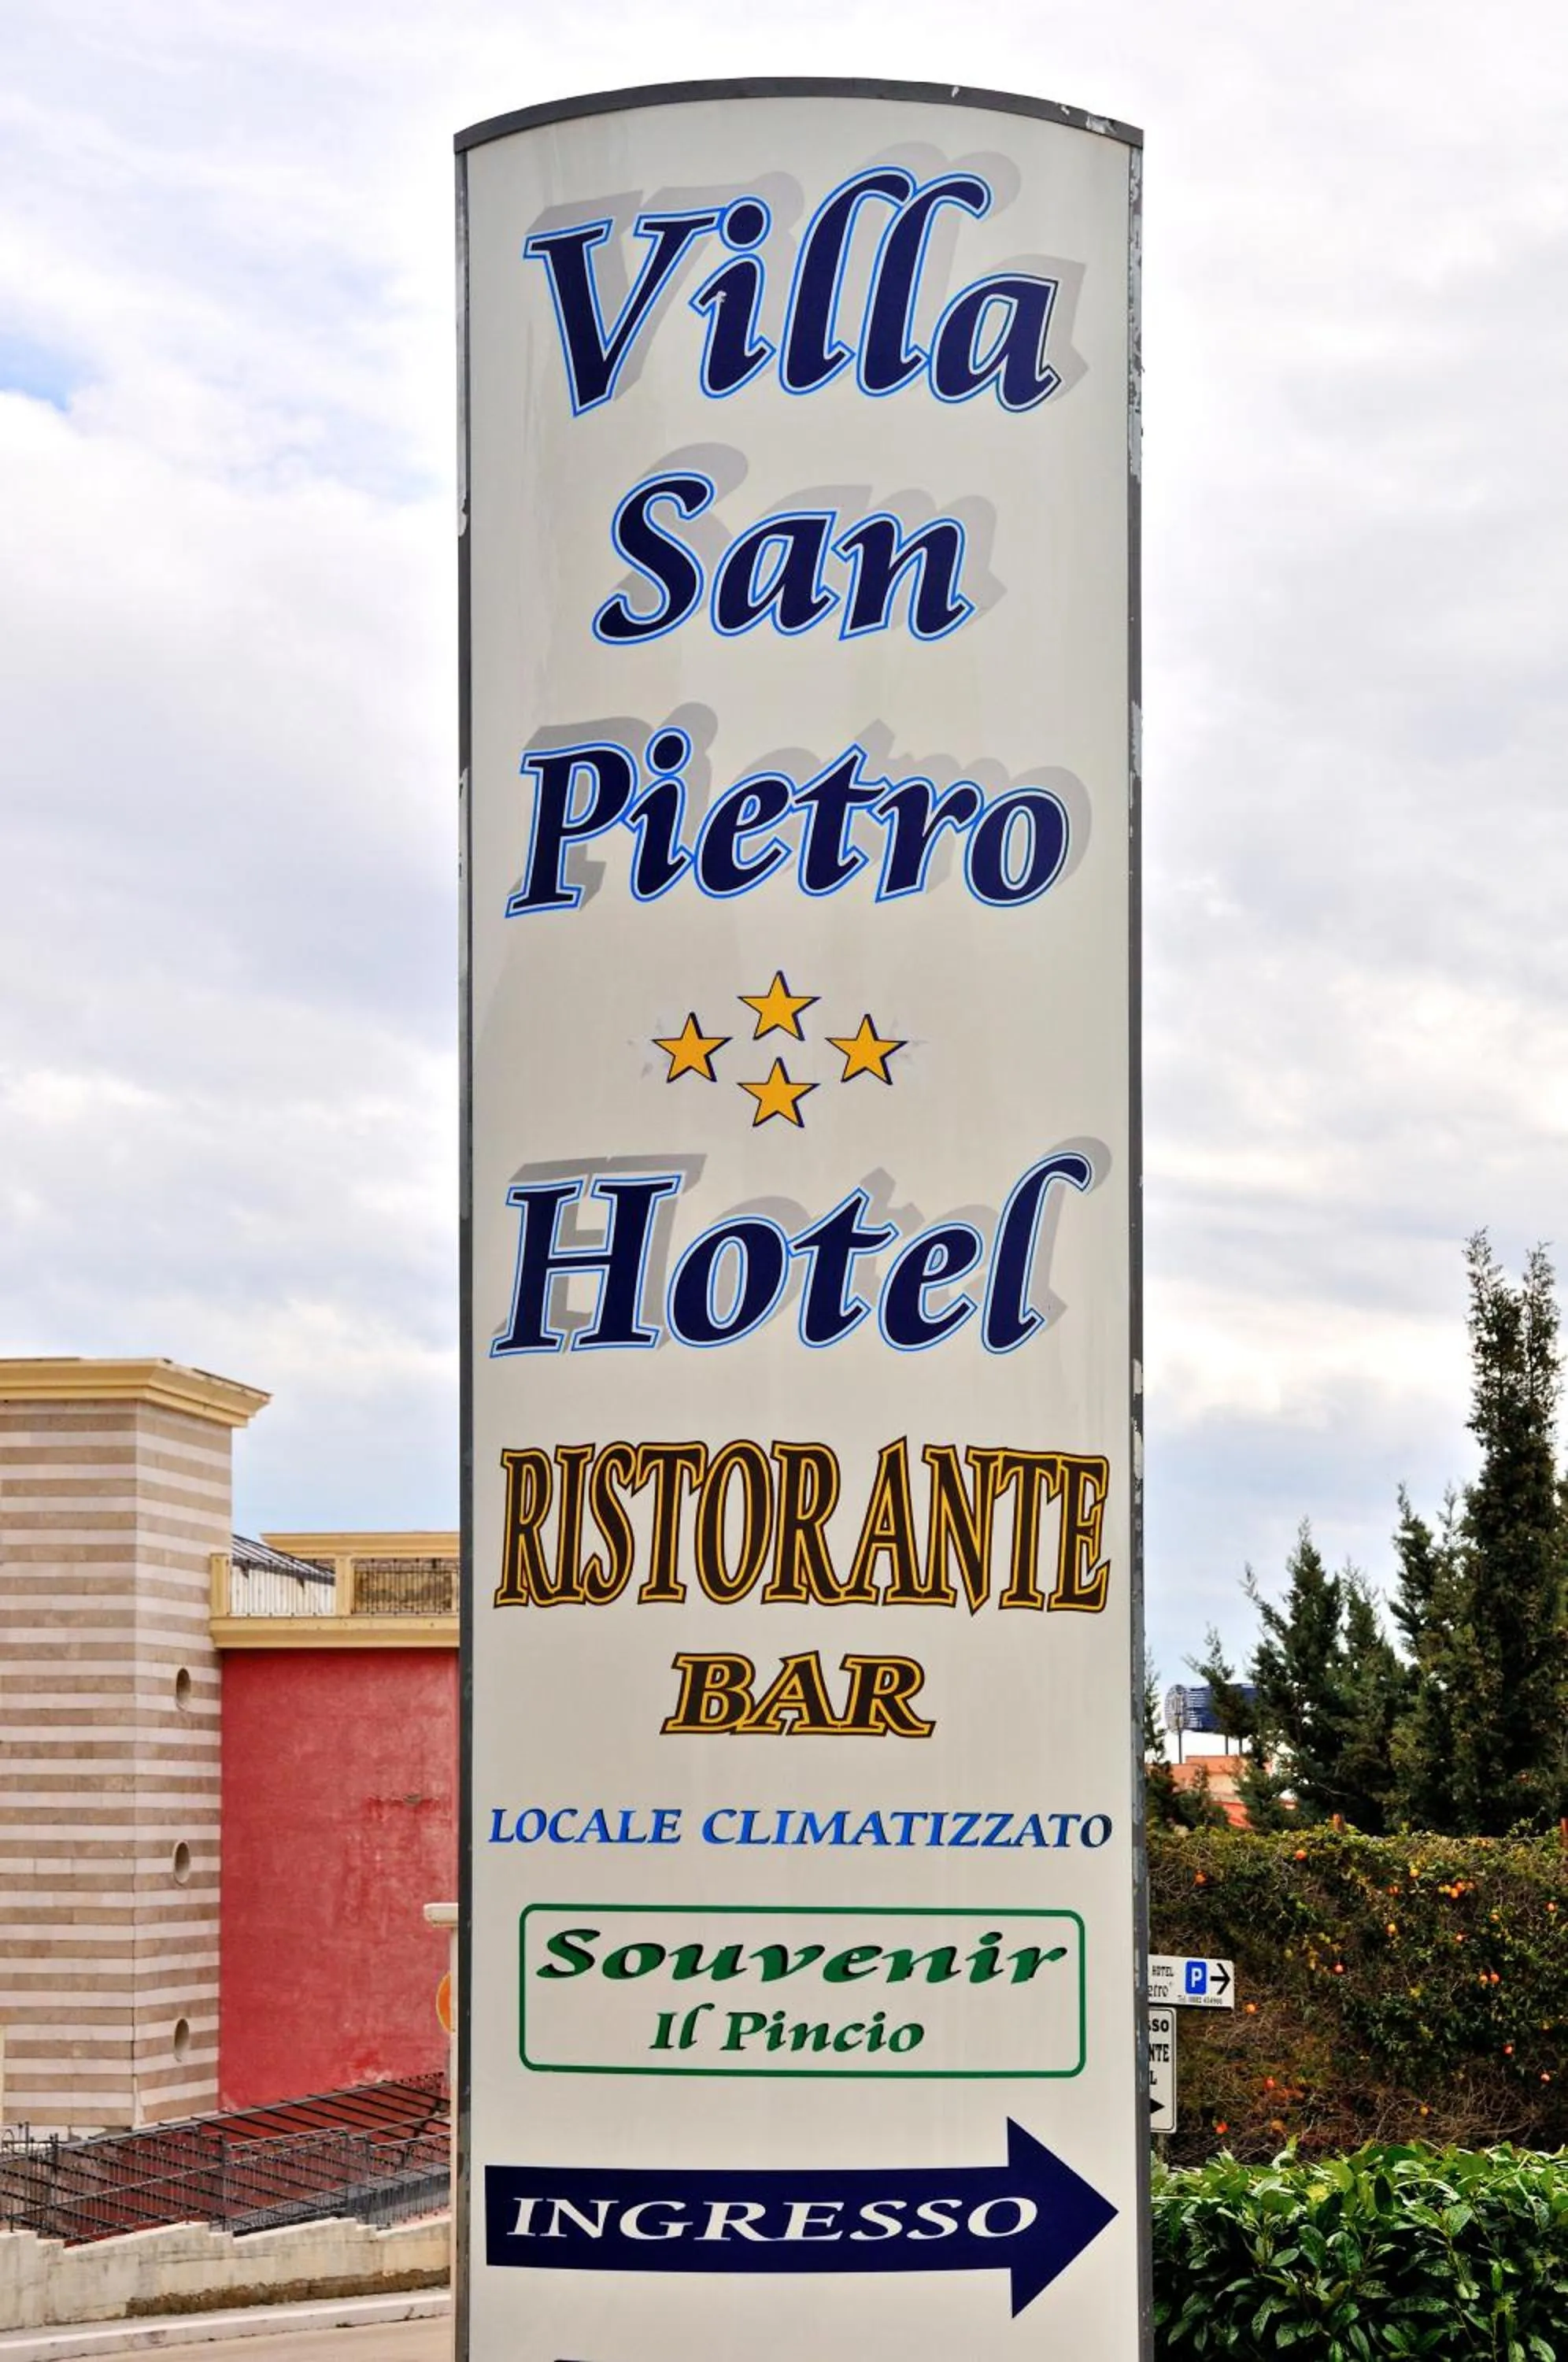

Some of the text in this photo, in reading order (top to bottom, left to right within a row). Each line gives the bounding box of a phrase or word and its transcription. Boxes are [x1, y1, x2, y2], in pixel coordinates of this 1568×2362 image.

[523, 166, 1063, 417] Villa
[592, 471, 975, 645] San
[506, 726, 1070, 918] Pietro
[490, 1152, 1093, 1358] Hotel
[494, 1436, 1111, 1616] RISTORANTE
[660, 1650, 936, 1738] BAR
[488, 1808, 1114, 1849] LOCALE CLIMATIZZATO
[535, 1928, 1067, 1985] Souvenir
[1152, 1965, 1174, 1977] HOTEL
[649, 2003, 925, 2053] Il Pincio
[506, 2196, 1038, 2242] INGRESSO
